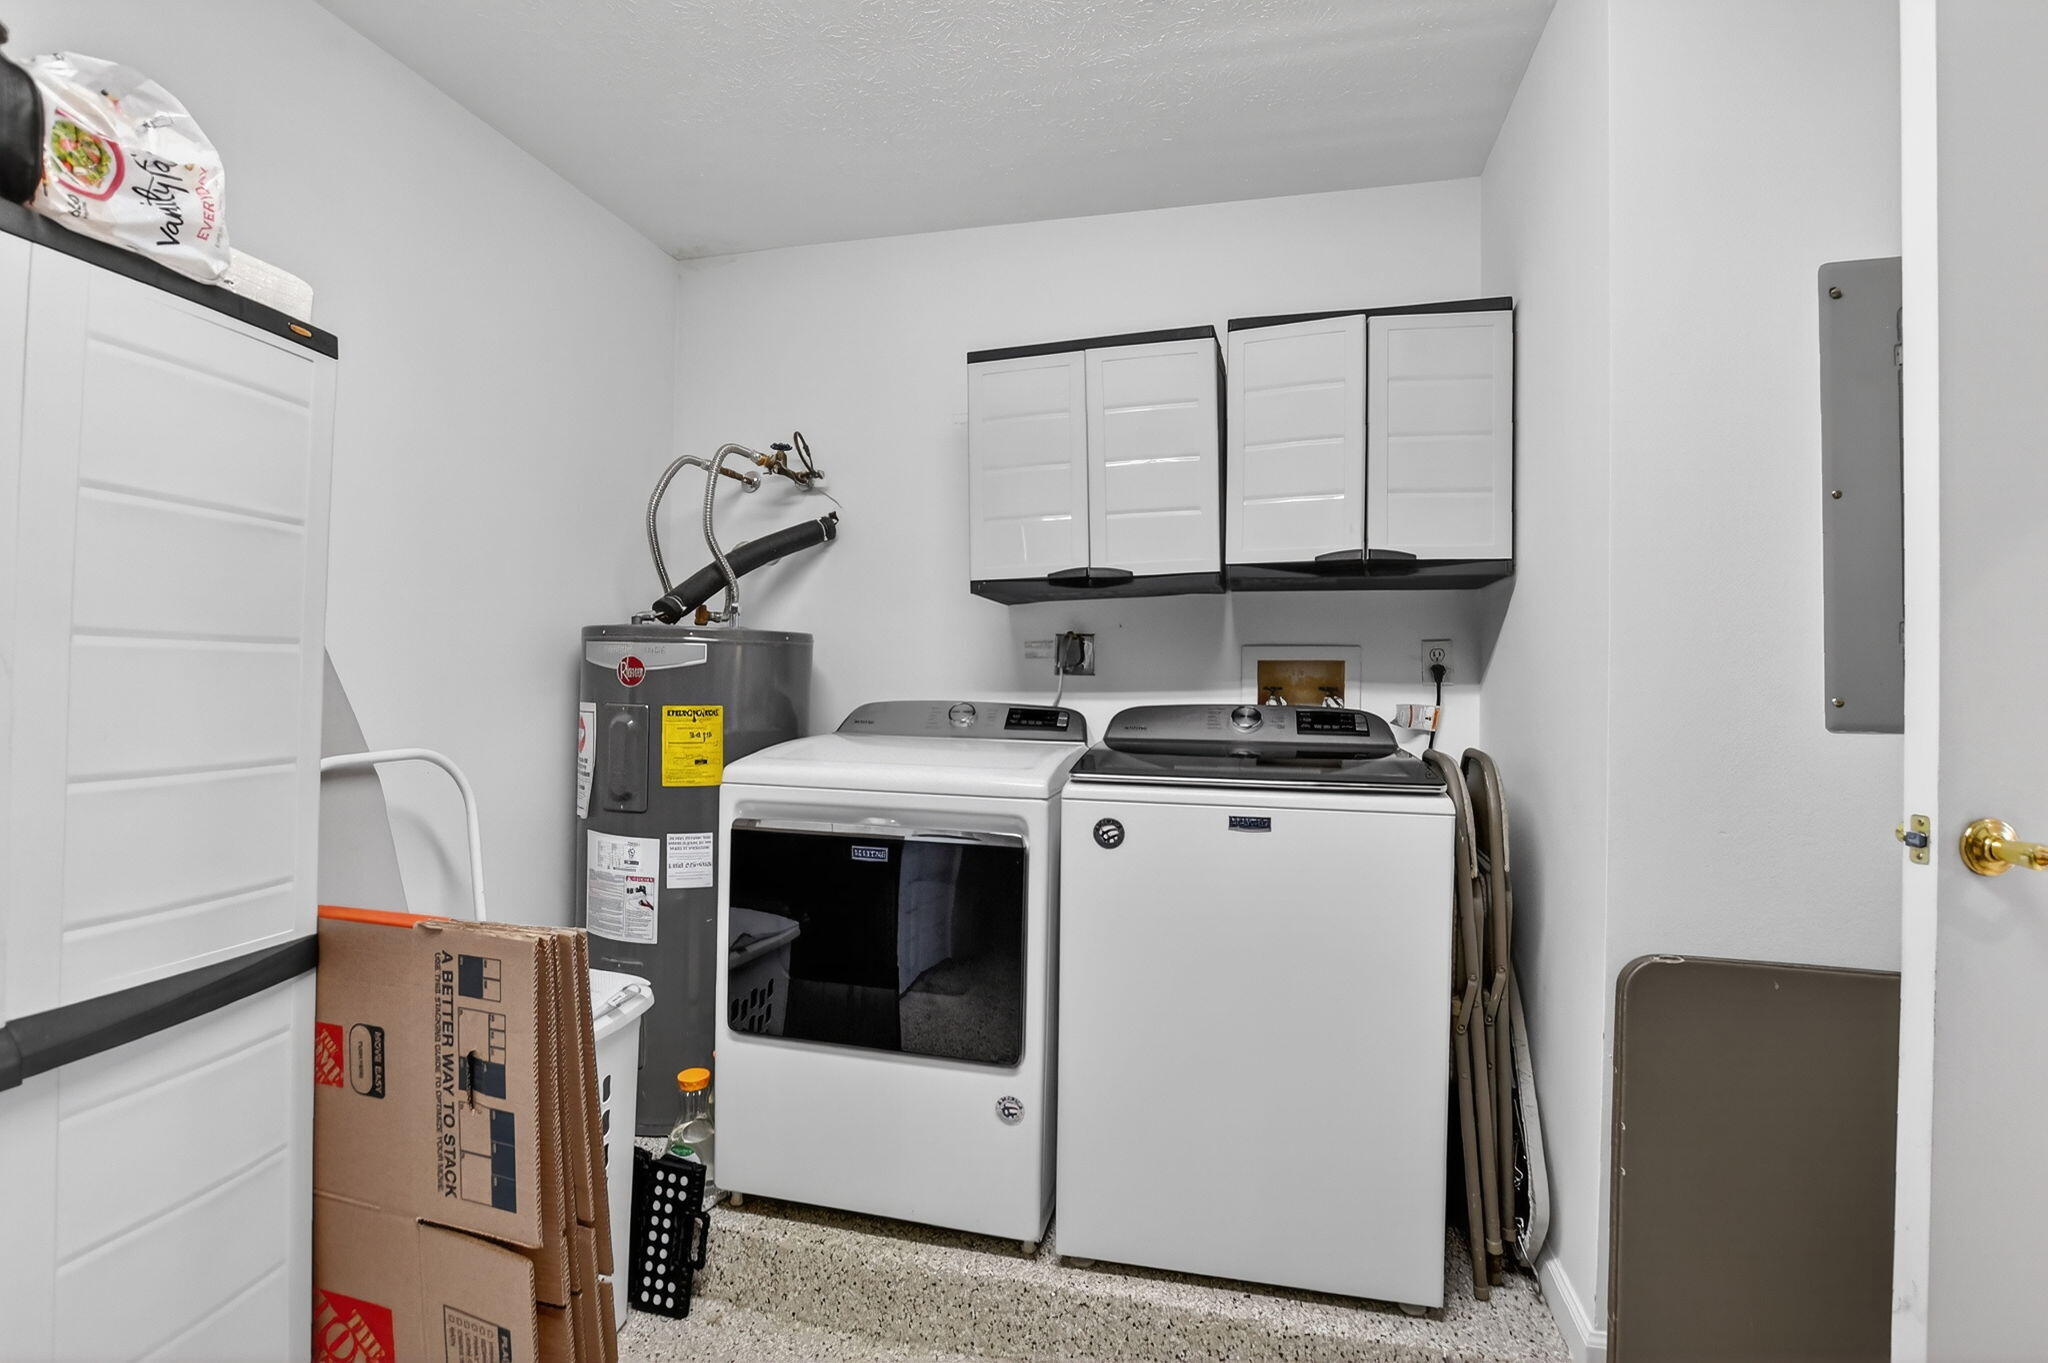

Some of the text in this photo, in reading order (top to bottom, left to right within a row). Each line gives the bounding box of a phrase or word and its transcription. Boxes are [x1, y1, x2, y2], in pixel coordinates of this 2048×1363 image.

[375, 1066, 383, 1094] EASY
[435, 1077, 441, 1089] TO
[441, 950, 457, 1198] A BETTER WAY TO STACK
[346, 1308, 386, 1359] THE
